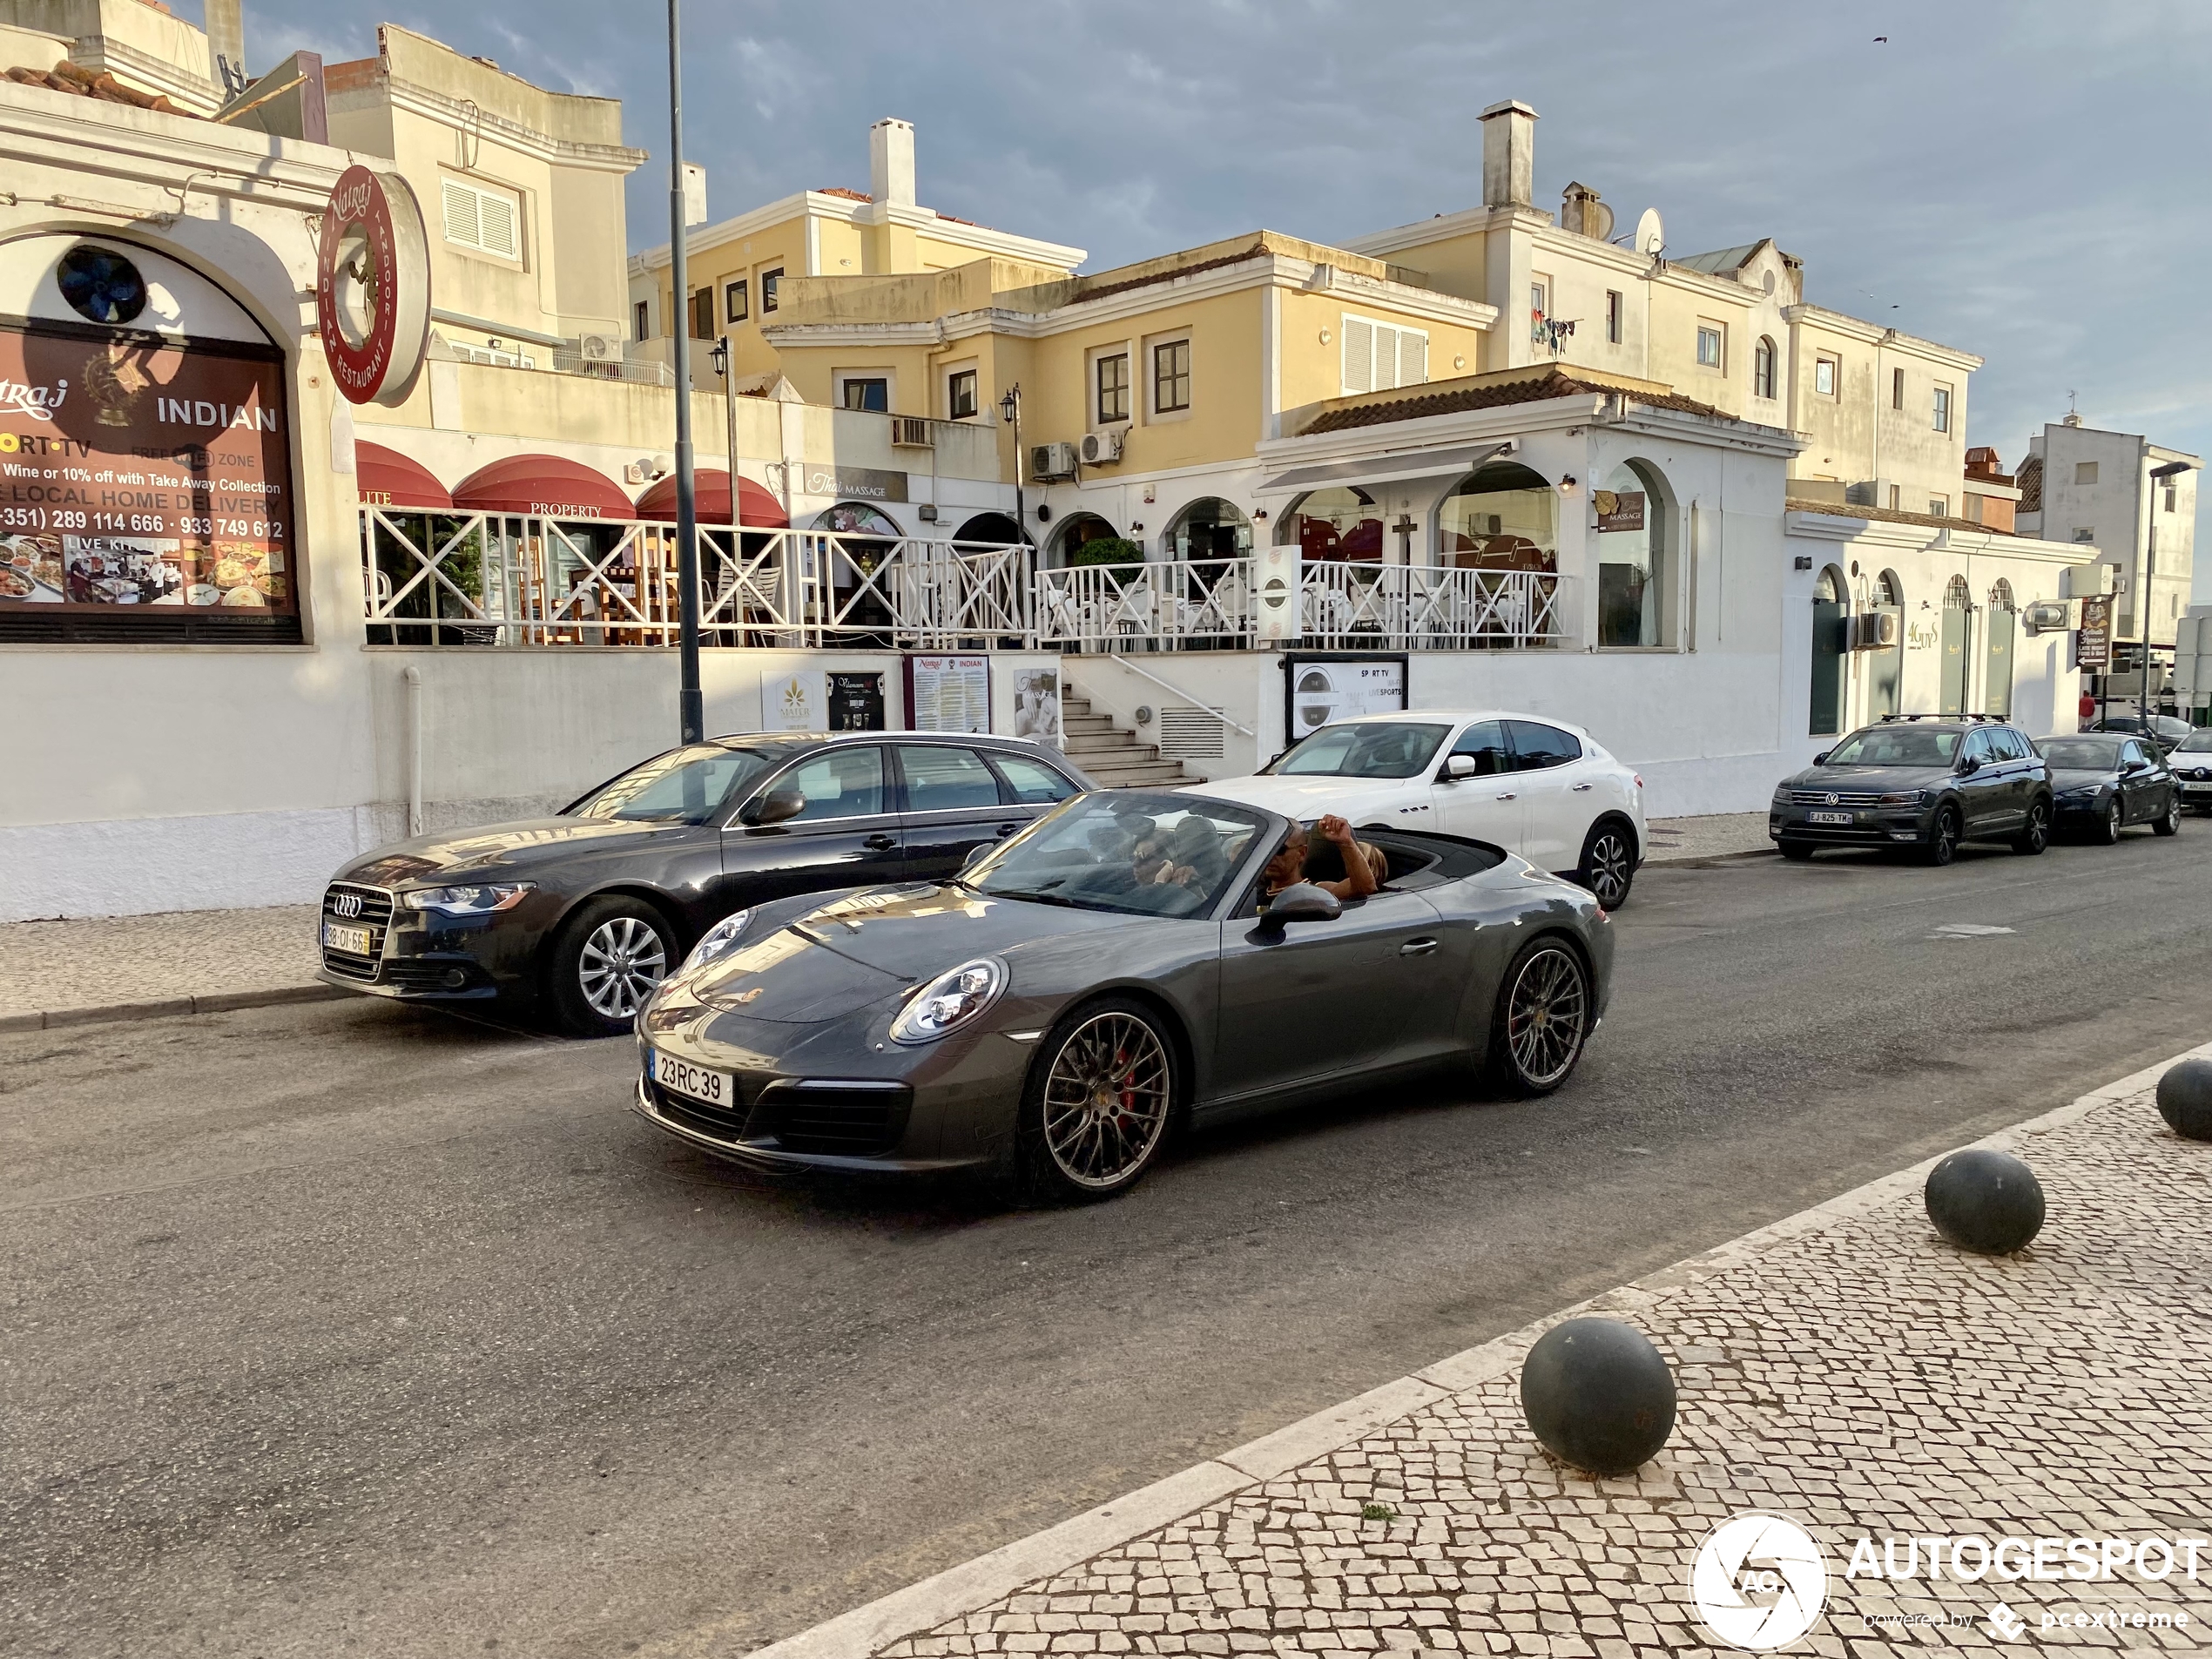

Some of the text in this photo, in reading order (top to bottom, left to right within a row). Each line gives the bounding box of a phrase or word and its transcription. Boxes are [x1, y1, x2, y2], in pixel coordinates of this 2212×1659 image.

[374, 210, 391, 331] TANDOORI
[323, 236, 337, 353] INDIAN
[336, 338, 385, 388] RESTAURANT
[158, 397, 277, 432] INDIAN
[132, 446, 169, 462] FREE
[219, 453, 255, 467] ZONE
[3, 462, 281, 495] Wine or 10% off with Take Away Collection
[806, 473, 886, 497] Thai MASSAGE
[12, 484, 95, 505] LOCAL
[102, 489, 169, 509] HOME
[176, 494, 280, 516] DELIVERY
[530, 502, 603, 518] PROPERTY
[52, 509, 86, 529] 289
[93, 512, 125, 530] 114
[131, 514, 164, 532] 666
[180, 516, 212, 534] 933
[217, 518, 248, 536] 749
[253, 520, 283, 538] 612
[1609, 512, 1642, 521] MASSAGE
[68, 536, 102, 550] LIVE
[1024, 691, 1053, 699] MASSAGE
[780, 707, 811, 716] MATER
